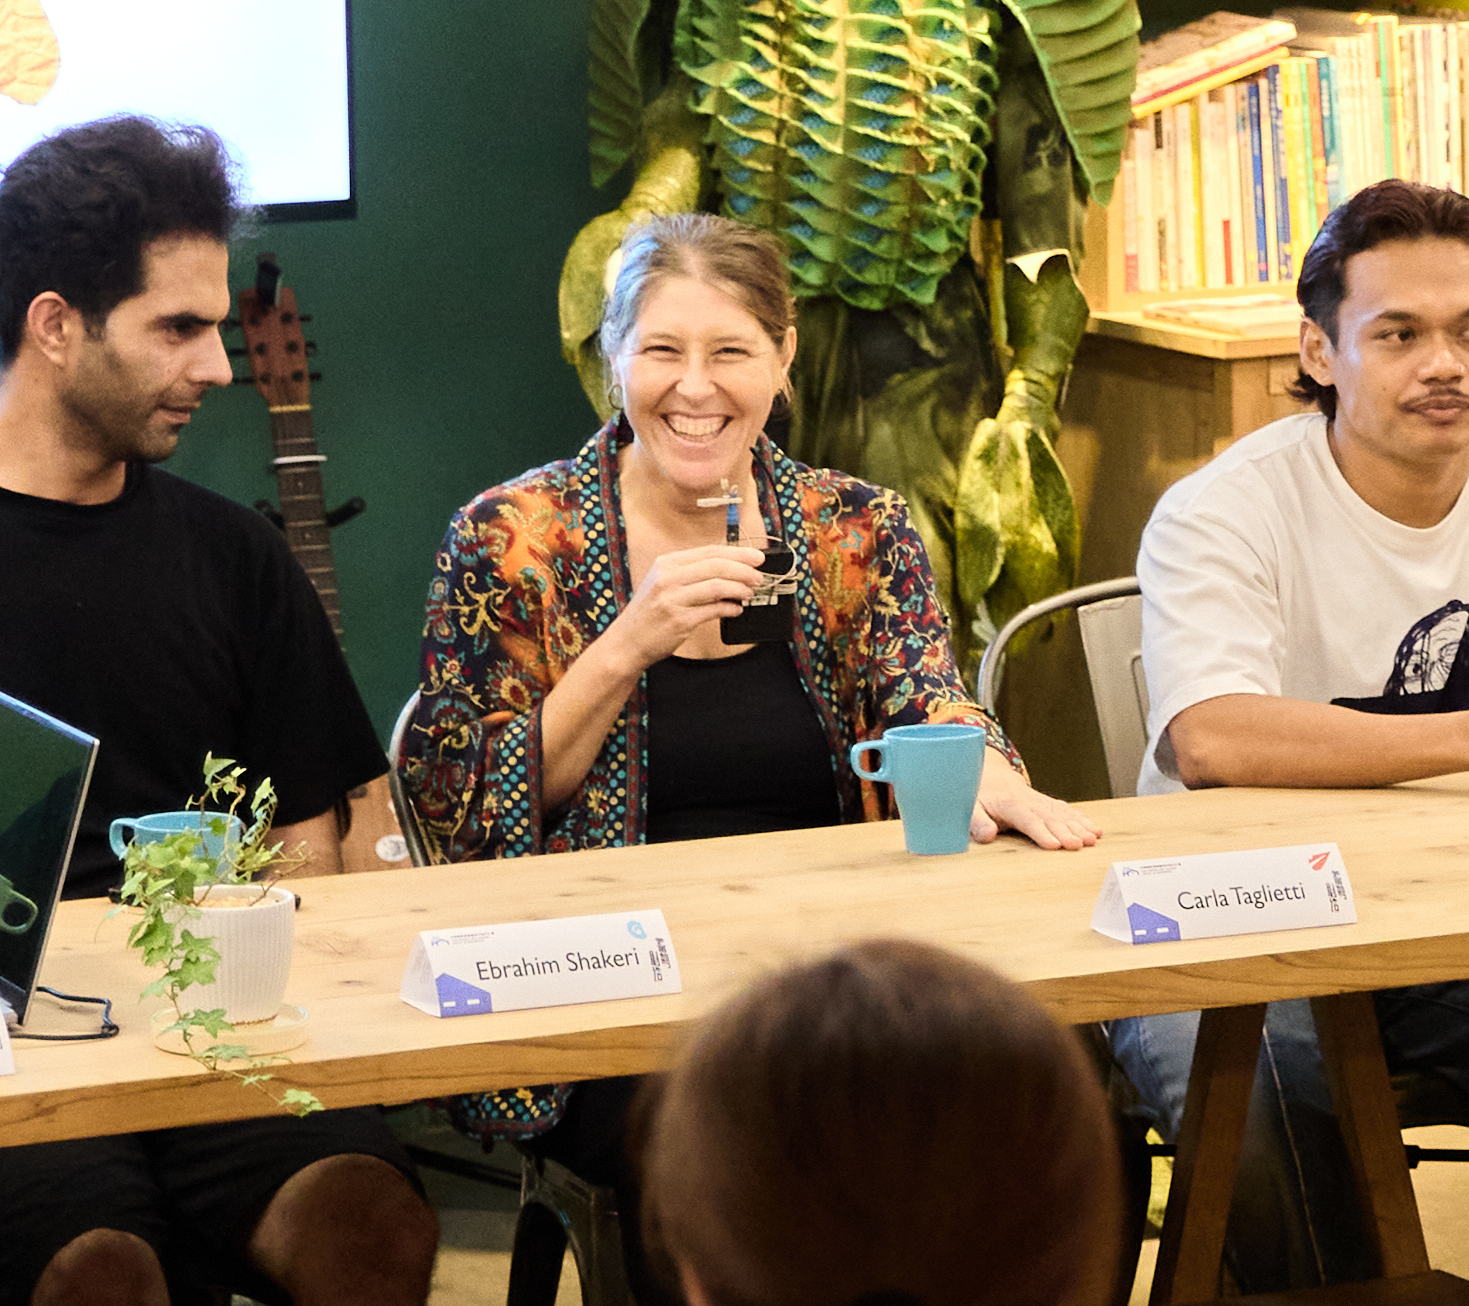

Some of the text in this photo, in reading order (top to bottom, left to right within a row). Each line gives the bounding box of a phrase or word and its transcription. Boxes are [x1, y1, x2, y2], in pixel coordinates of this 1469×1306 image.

[1177, 889, 1230, 910] Carla
[1230, 882, 1306, 909] Taglietti
[476, 957, 560, 981] Ebrahim
[565, 947, 640, 973] Shakeri
